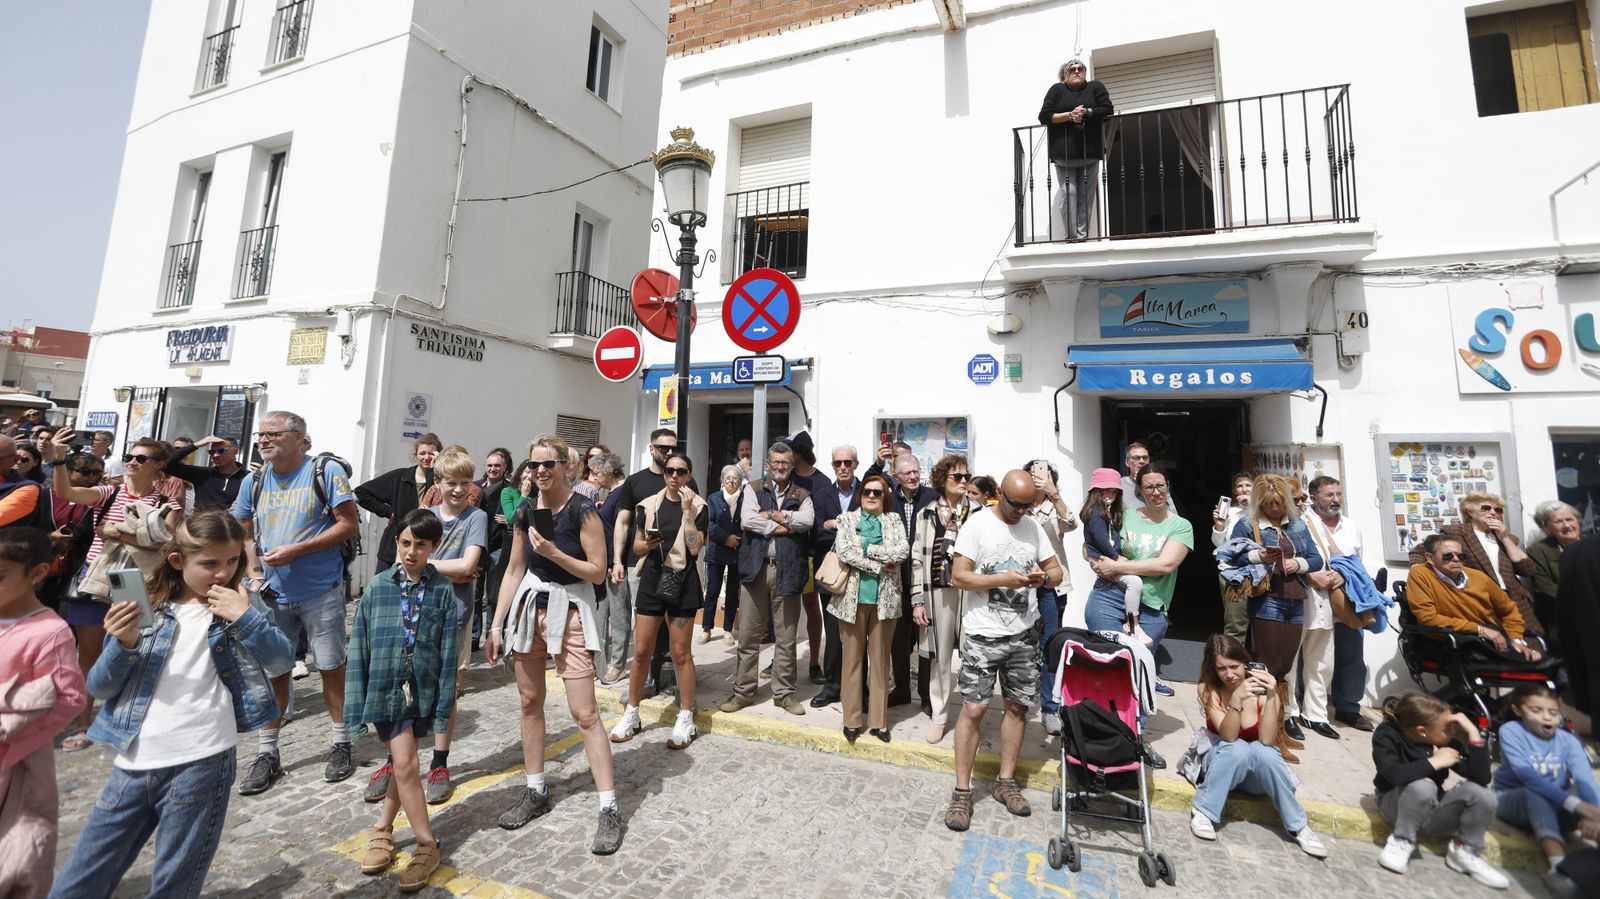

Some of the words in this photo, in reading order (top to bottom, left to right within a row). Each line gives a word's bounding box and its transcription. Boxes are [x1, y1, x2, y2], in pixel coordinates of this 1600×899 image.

[1165, 299, 1217, 321] Marea
[1347, 311, 1368, 328] 40
[410, 323, 485, 350] SANTISIMA
[417, 337, 483, 361] TRINIDAD
[974, 363, 994, 374] ADT
[1129, 368, 1253, 389] Regalos
